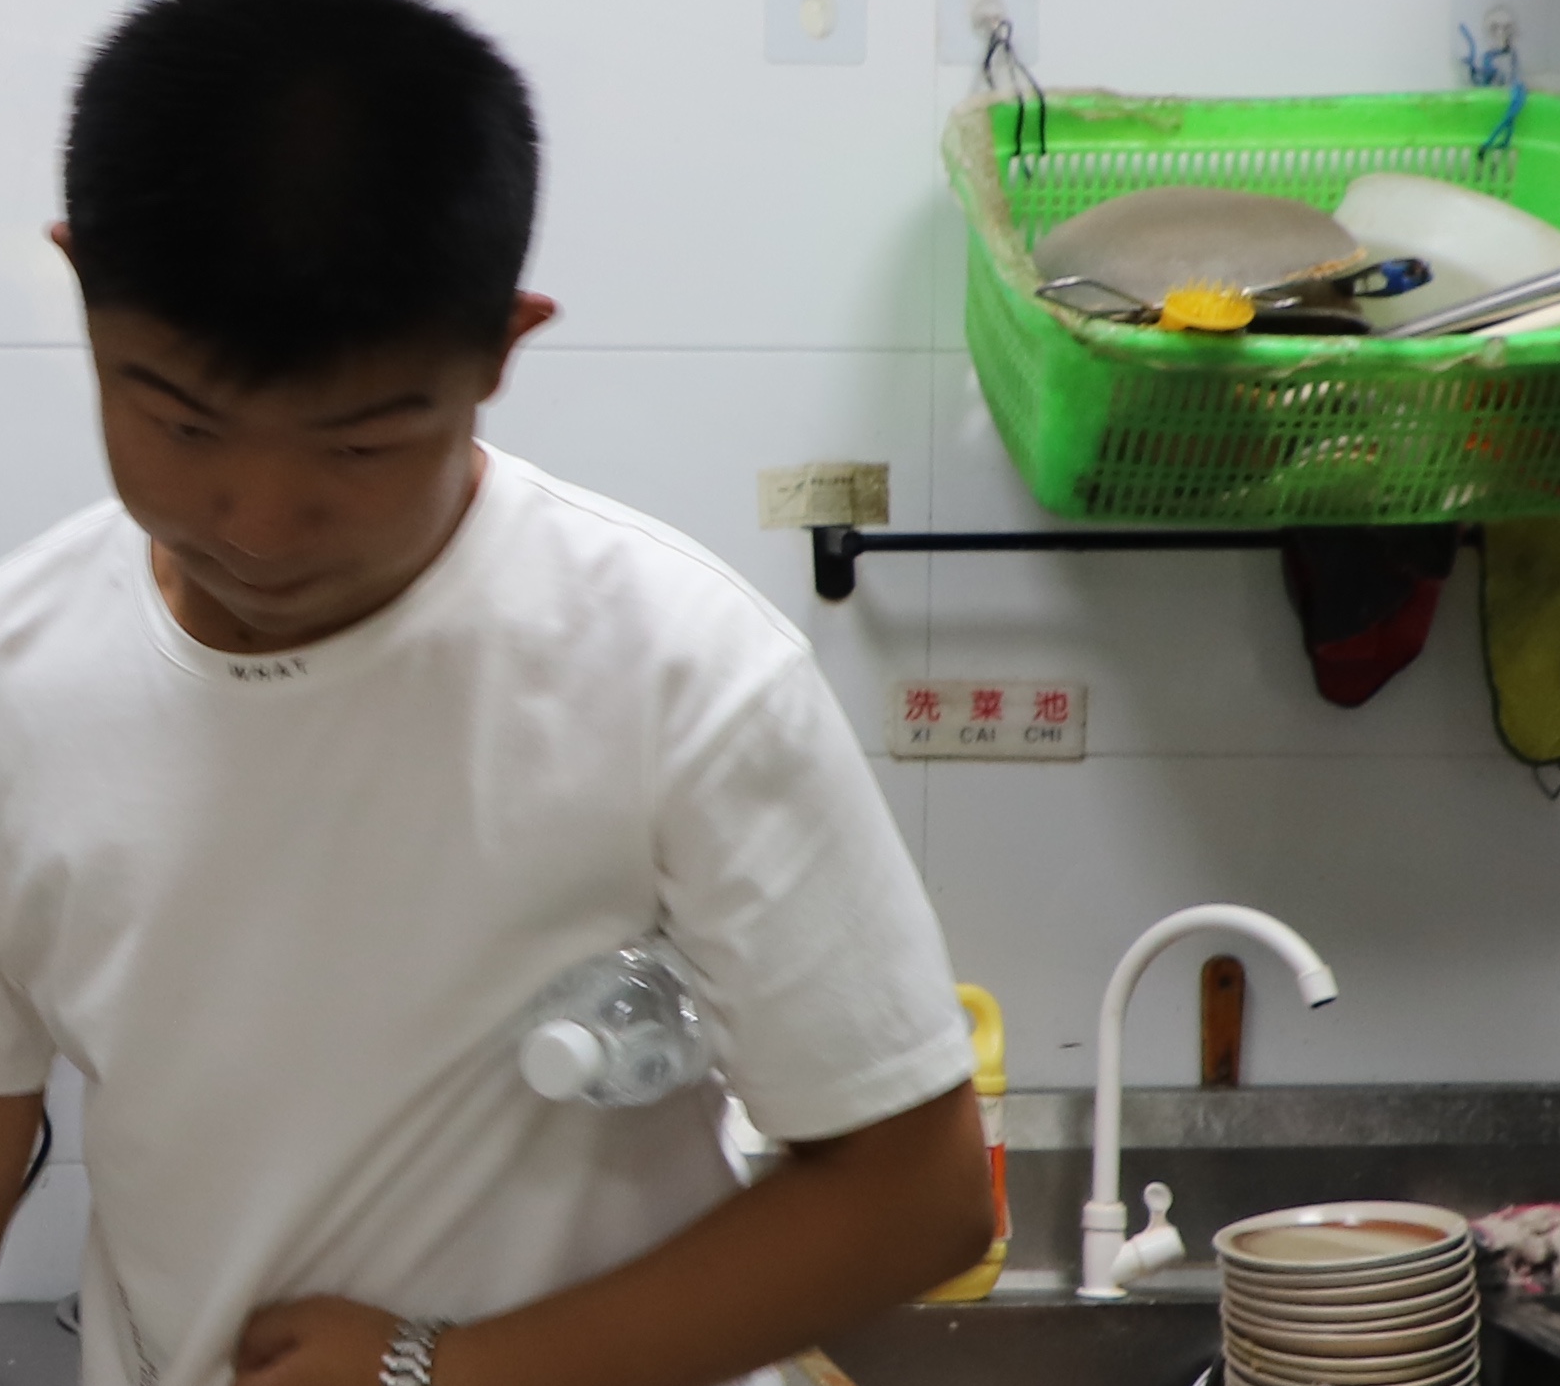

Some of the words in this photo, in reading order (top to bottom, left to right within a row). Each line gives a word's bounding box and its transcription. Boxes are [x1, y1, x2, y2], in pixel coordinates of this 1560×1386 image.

[905, 688, 1069, 723] 洗菜池
[911, 727, 931, 743] XI
[959, 726, 997, 744] CAI
[1024, 726, 1063, 744] CHI
